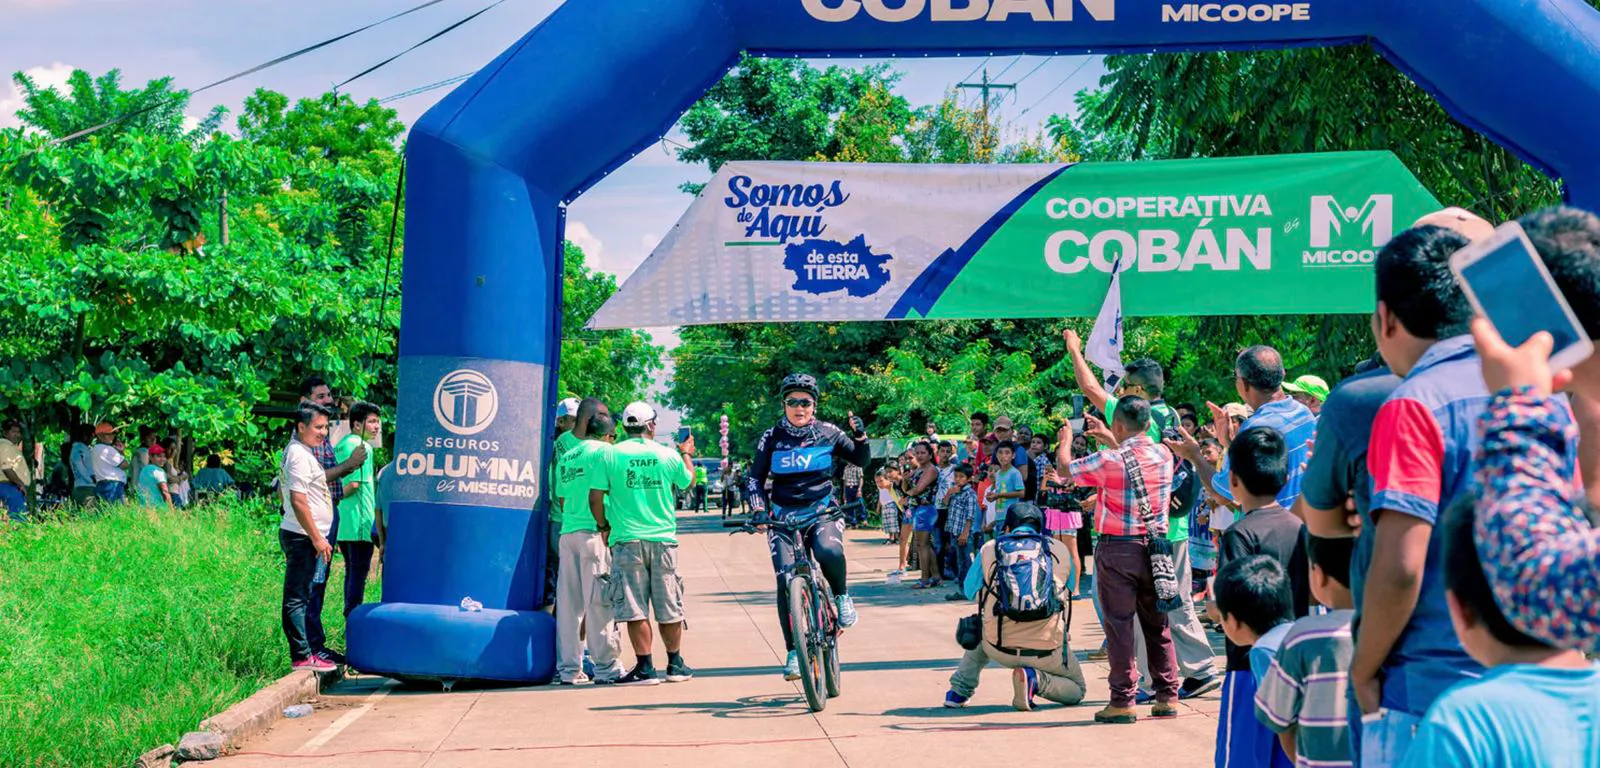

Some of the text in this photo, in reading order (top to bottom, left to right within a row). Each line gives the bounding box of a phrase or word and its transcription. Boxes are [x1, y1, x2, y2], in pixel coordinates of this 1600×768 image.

[1161, 3, 1311, 22] MICOOPE
[724, 175, 850, 208] Somos
[1045, 194, 1272, 219] COOPERATIVA
[737, 206, 827, 244] de Aquí
[1044, 218, 1271, 273] COBÁN
[807, 250, 858, 263] de esta
[1302, 250, 1379, 264] MICOO
[803, 264, 870, 280] TIERRA
[425, 437, 500, 451] SEGUROS
[395, 452, 536, 483] COLUMNA
[628, 458, 659, 467] STAFF
[780, 451, 813, 470] sky
[436, 480, 534, 498] es MISEGURO
